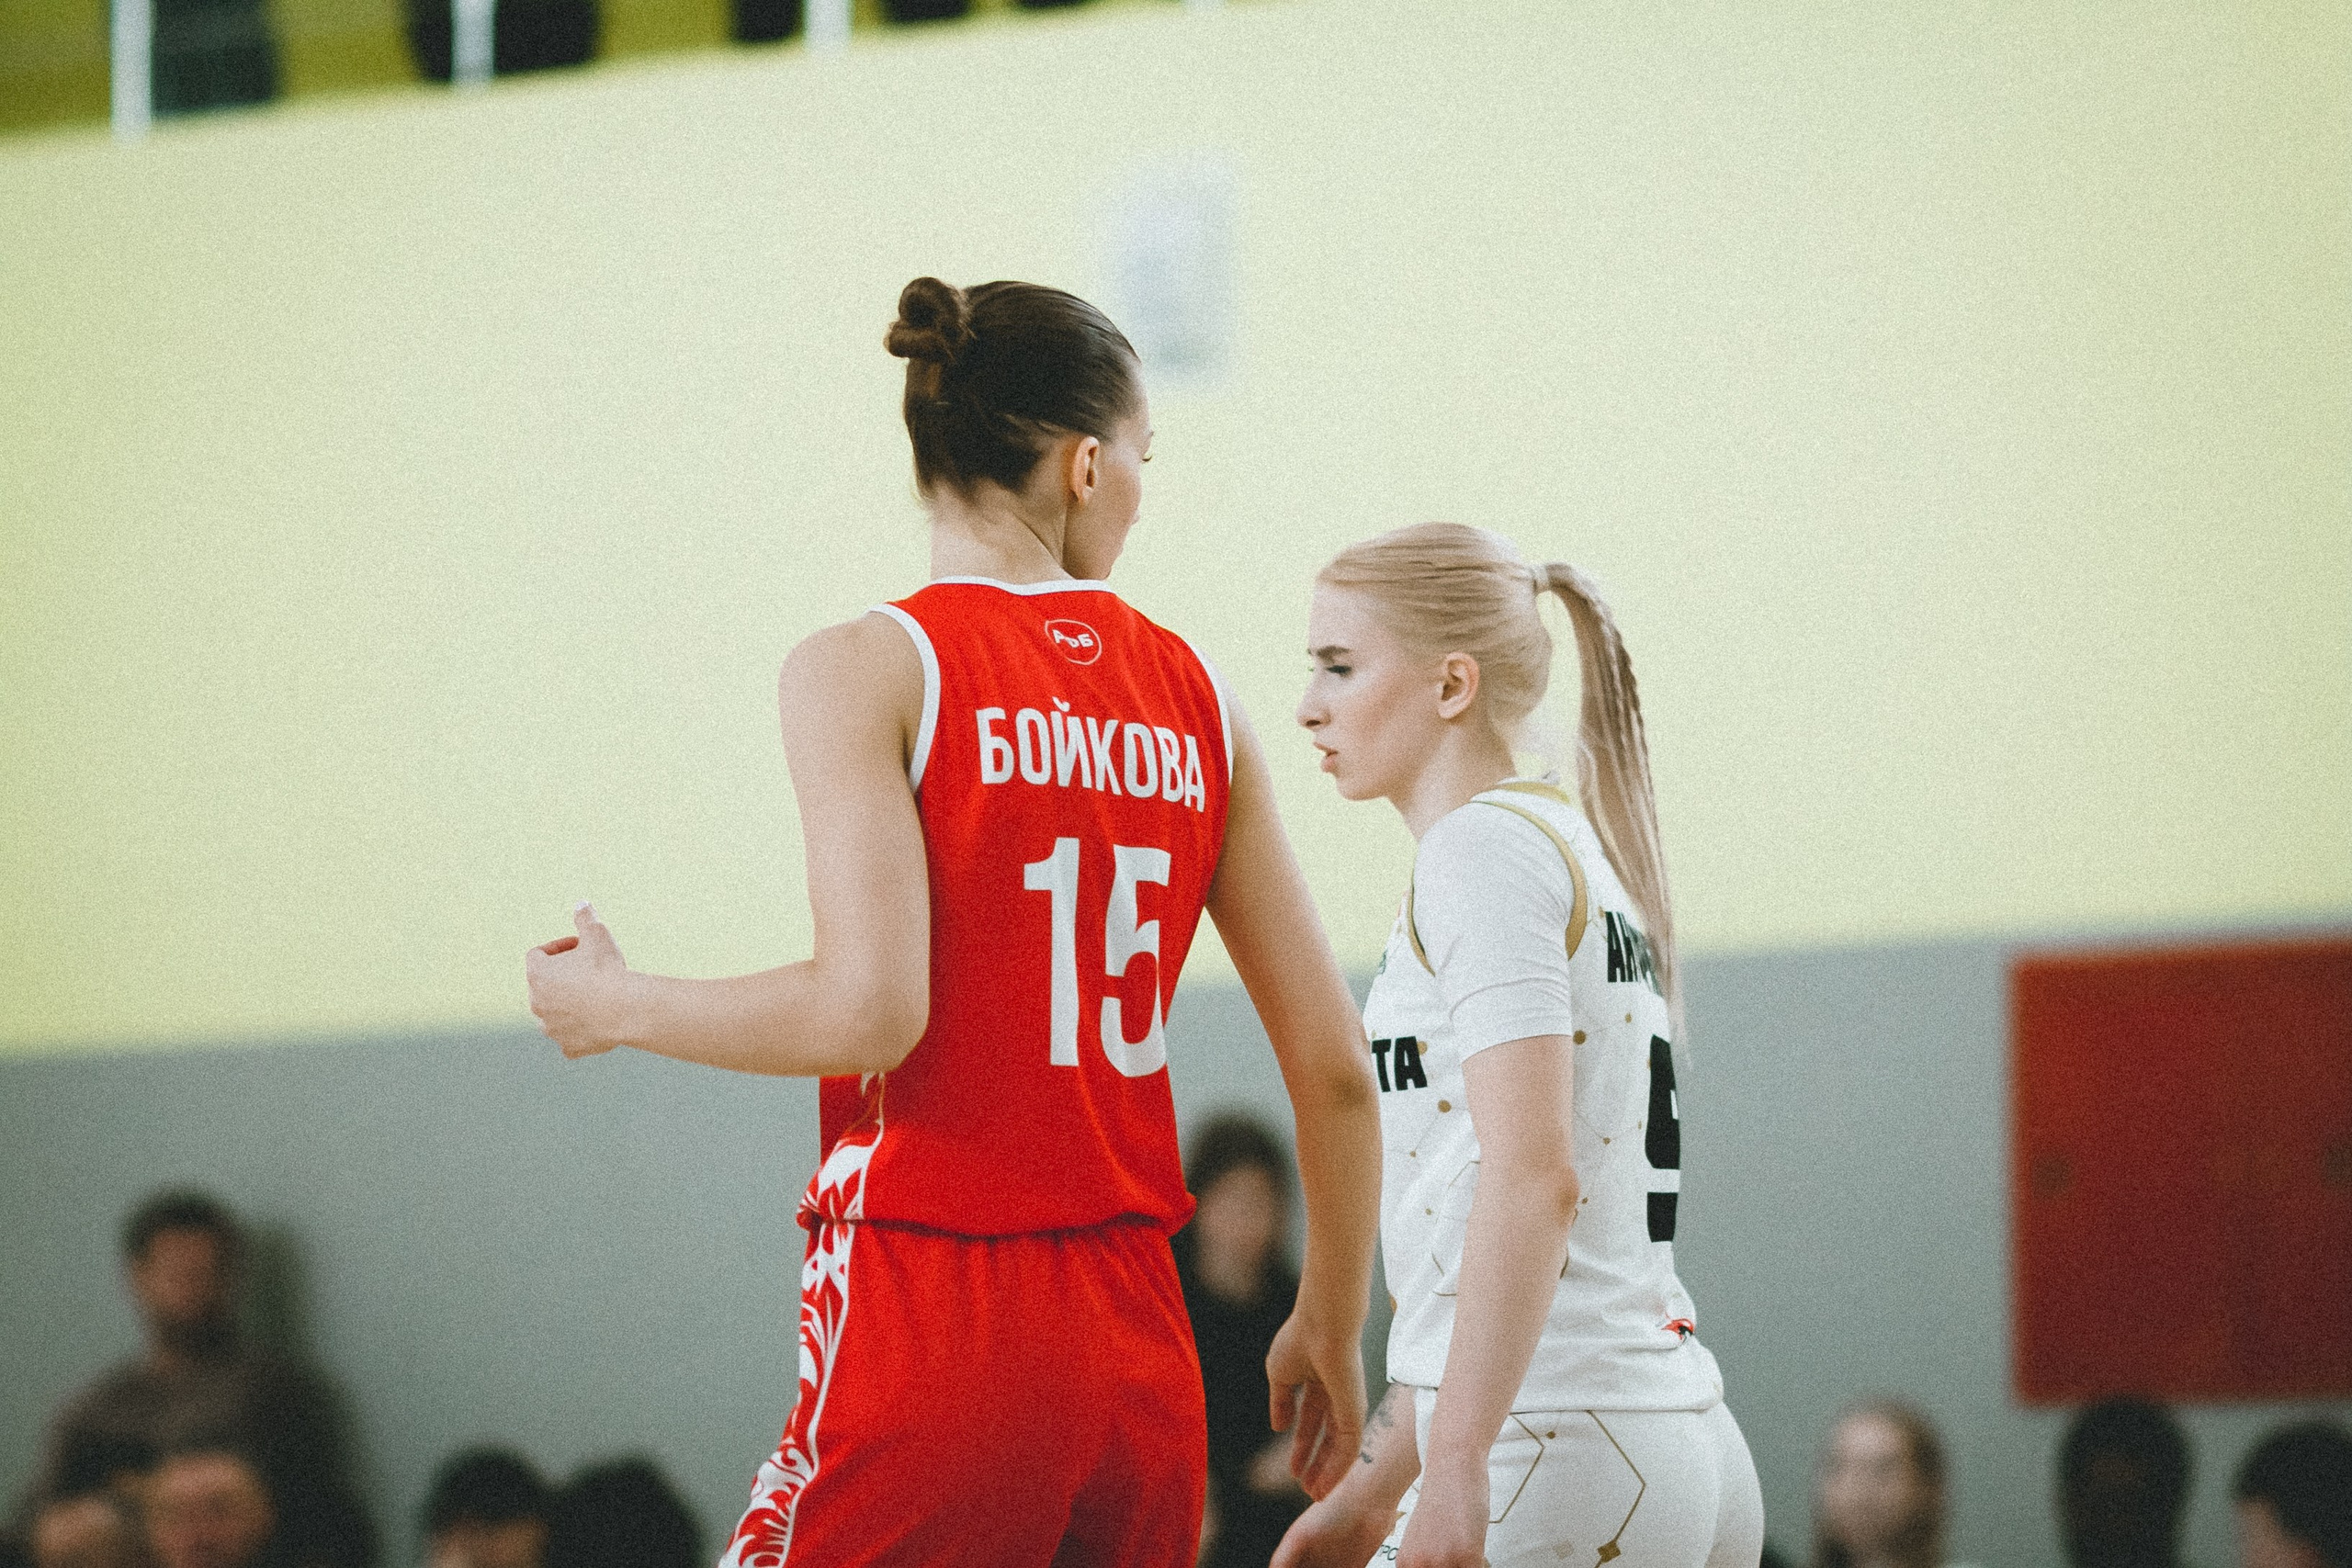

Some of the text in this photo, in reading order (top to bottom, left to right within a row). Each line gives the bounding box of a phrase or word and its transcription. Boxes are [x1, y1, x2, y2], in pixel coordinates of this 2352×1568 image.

[976, 695, 1205, 813] БОЙКОВА
[1023, 837, 1171, 1078] 15
[1372, 1035, 1428, 1092] ТА
